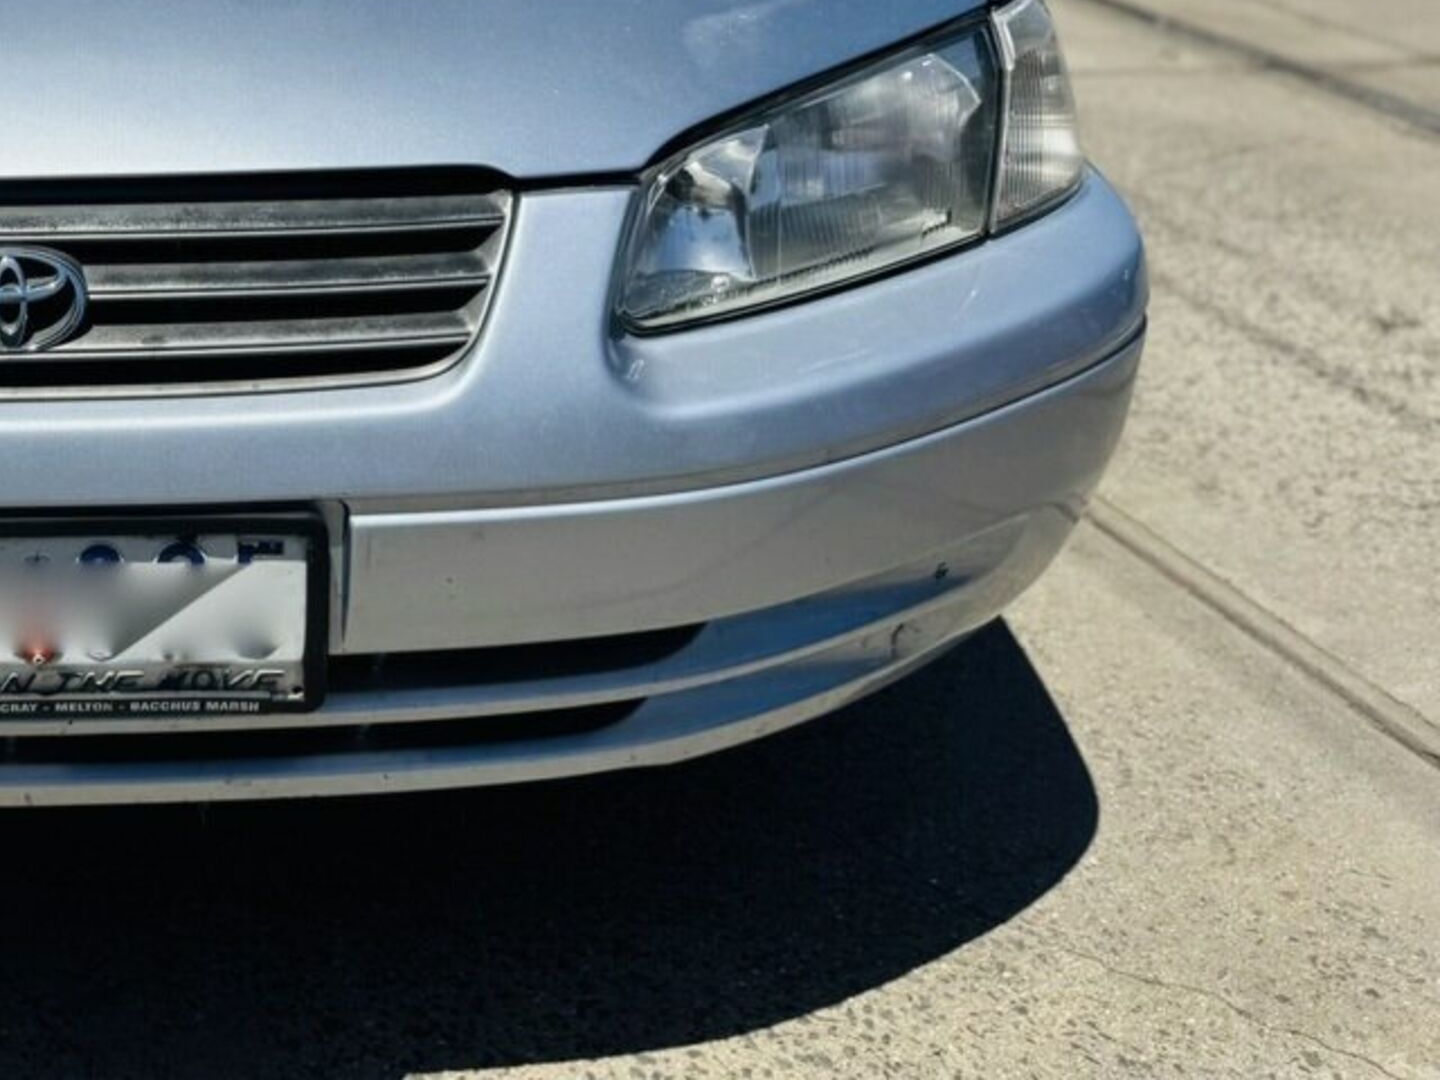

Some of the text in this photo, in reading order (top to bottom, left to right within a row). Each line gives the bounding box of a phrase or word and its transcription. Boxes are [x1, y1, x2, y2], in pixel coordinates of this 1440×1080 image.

[54, 701, 115, 713] MELTON
[130, 700, 201, 712] BACCHUS
[205, 700, 260, 712] MARSH
